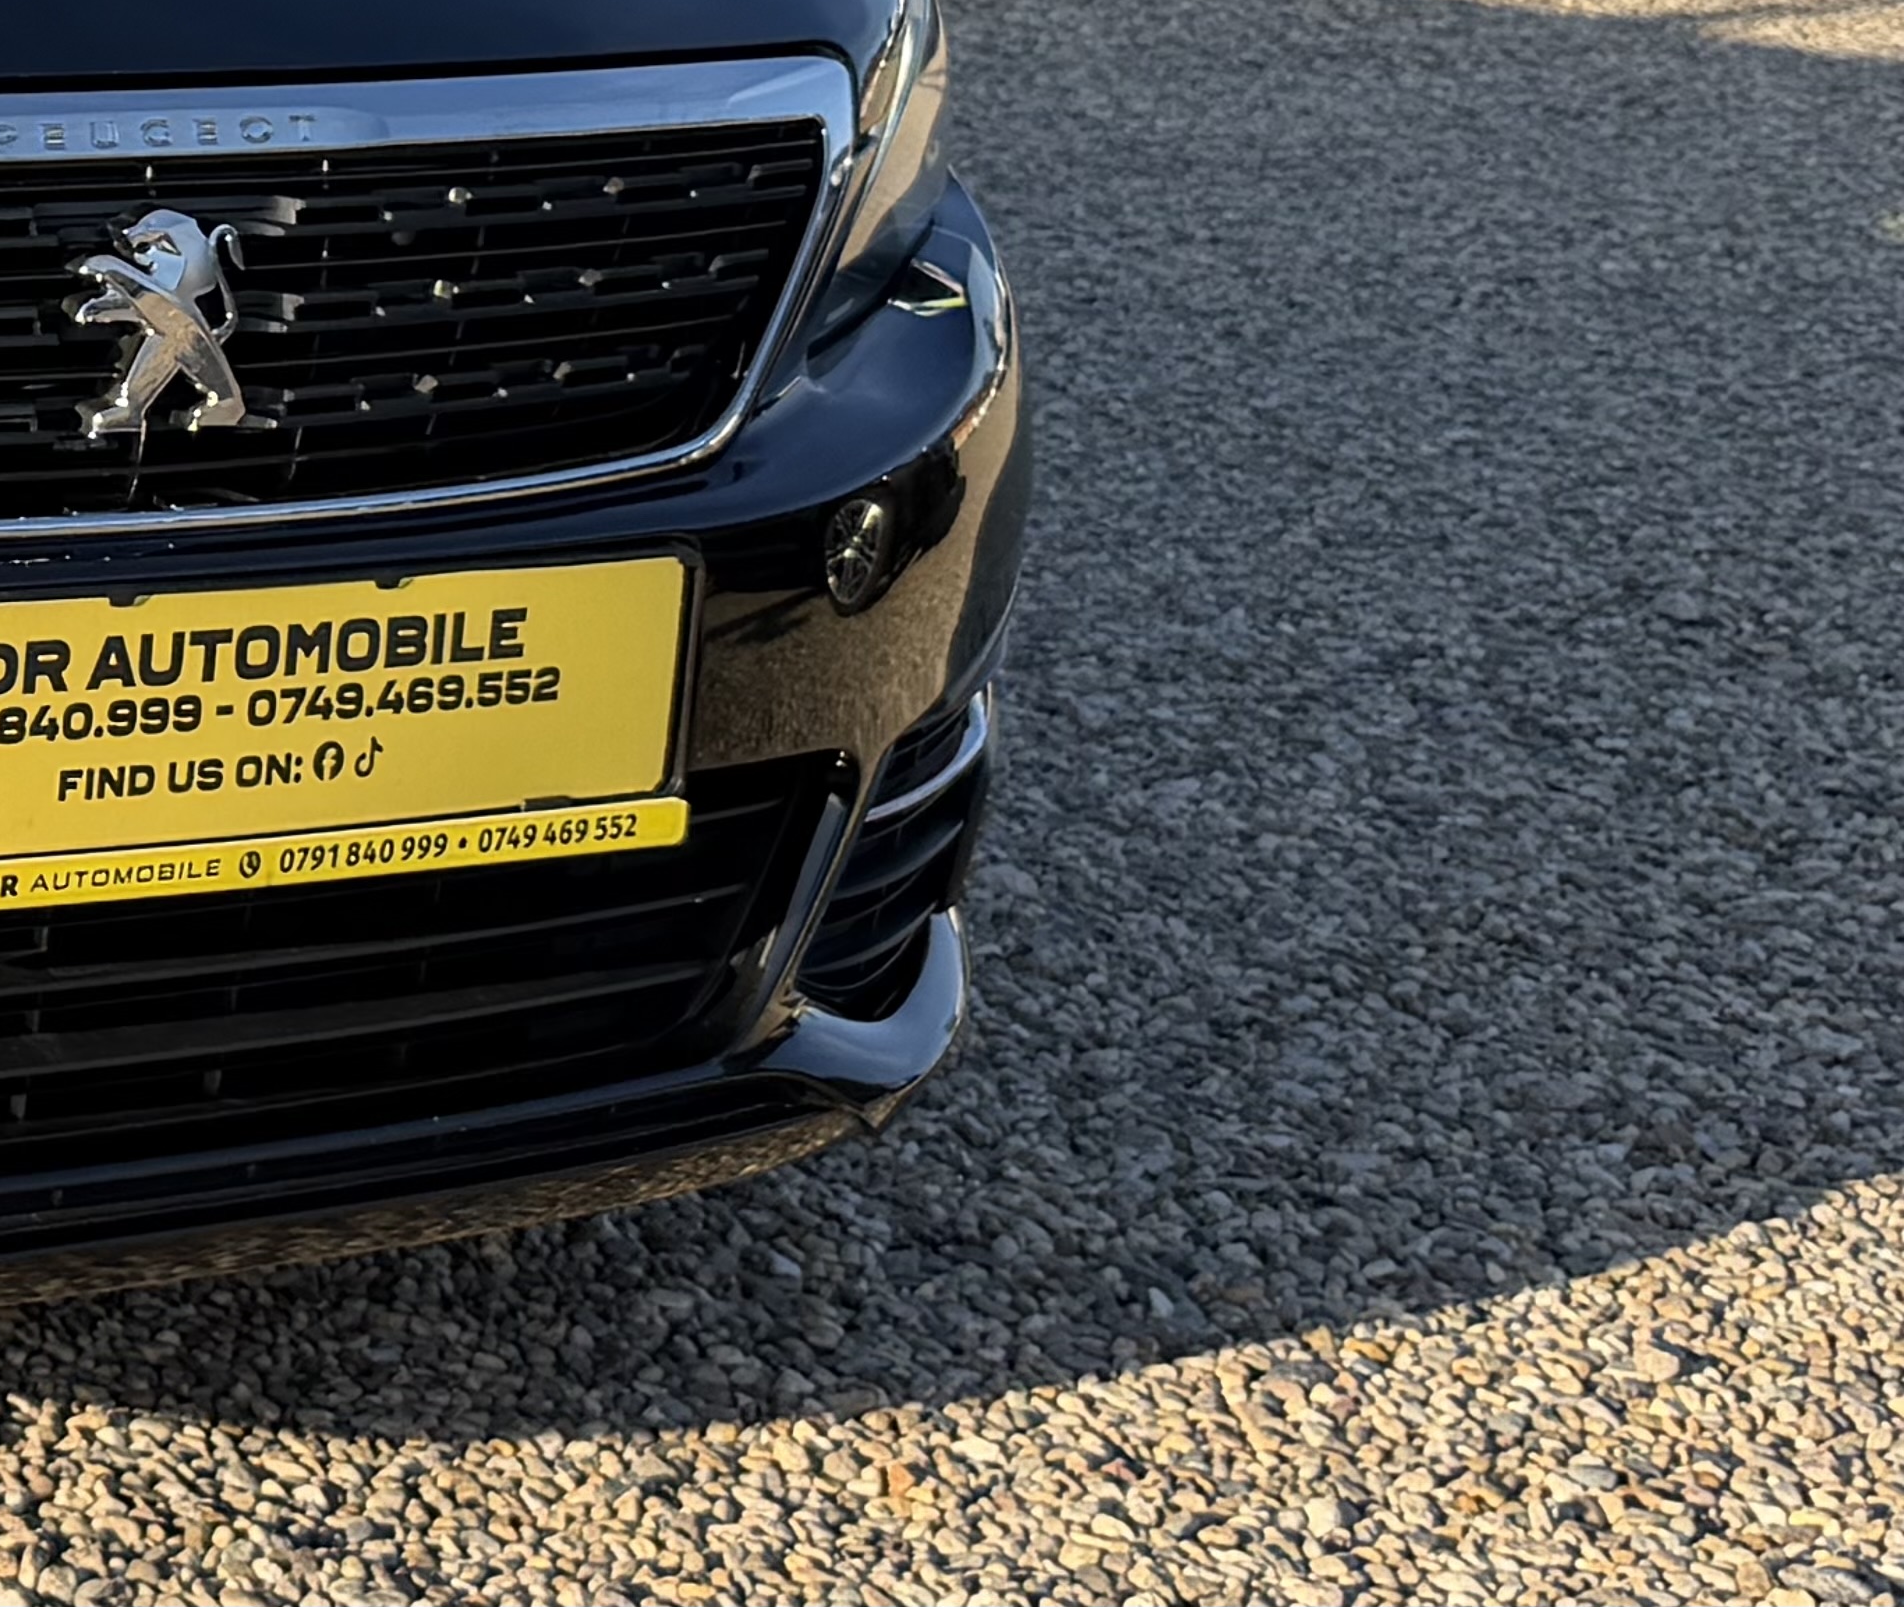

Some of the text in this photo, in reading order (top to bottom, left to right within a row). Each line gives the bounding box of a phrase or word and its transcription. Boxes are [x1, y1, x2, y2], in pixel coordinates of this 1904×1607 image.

[85, 606, 529, 691] AUTOMOBILE
[246, 666, 562, 727] 0749.469.552
[56, 751, 304, 802] FIND US ON:
[29, 857, 222, 893] AUTOMOBILE
[278, 843, 341, 874] 0791
[344, 837, 394, 868] 840
[400, 832, 449, 861] 999
[478, 823, 537, 854] 0749
[542, 817, 589, 846] 469
[593, 812, 638, 841] 552
